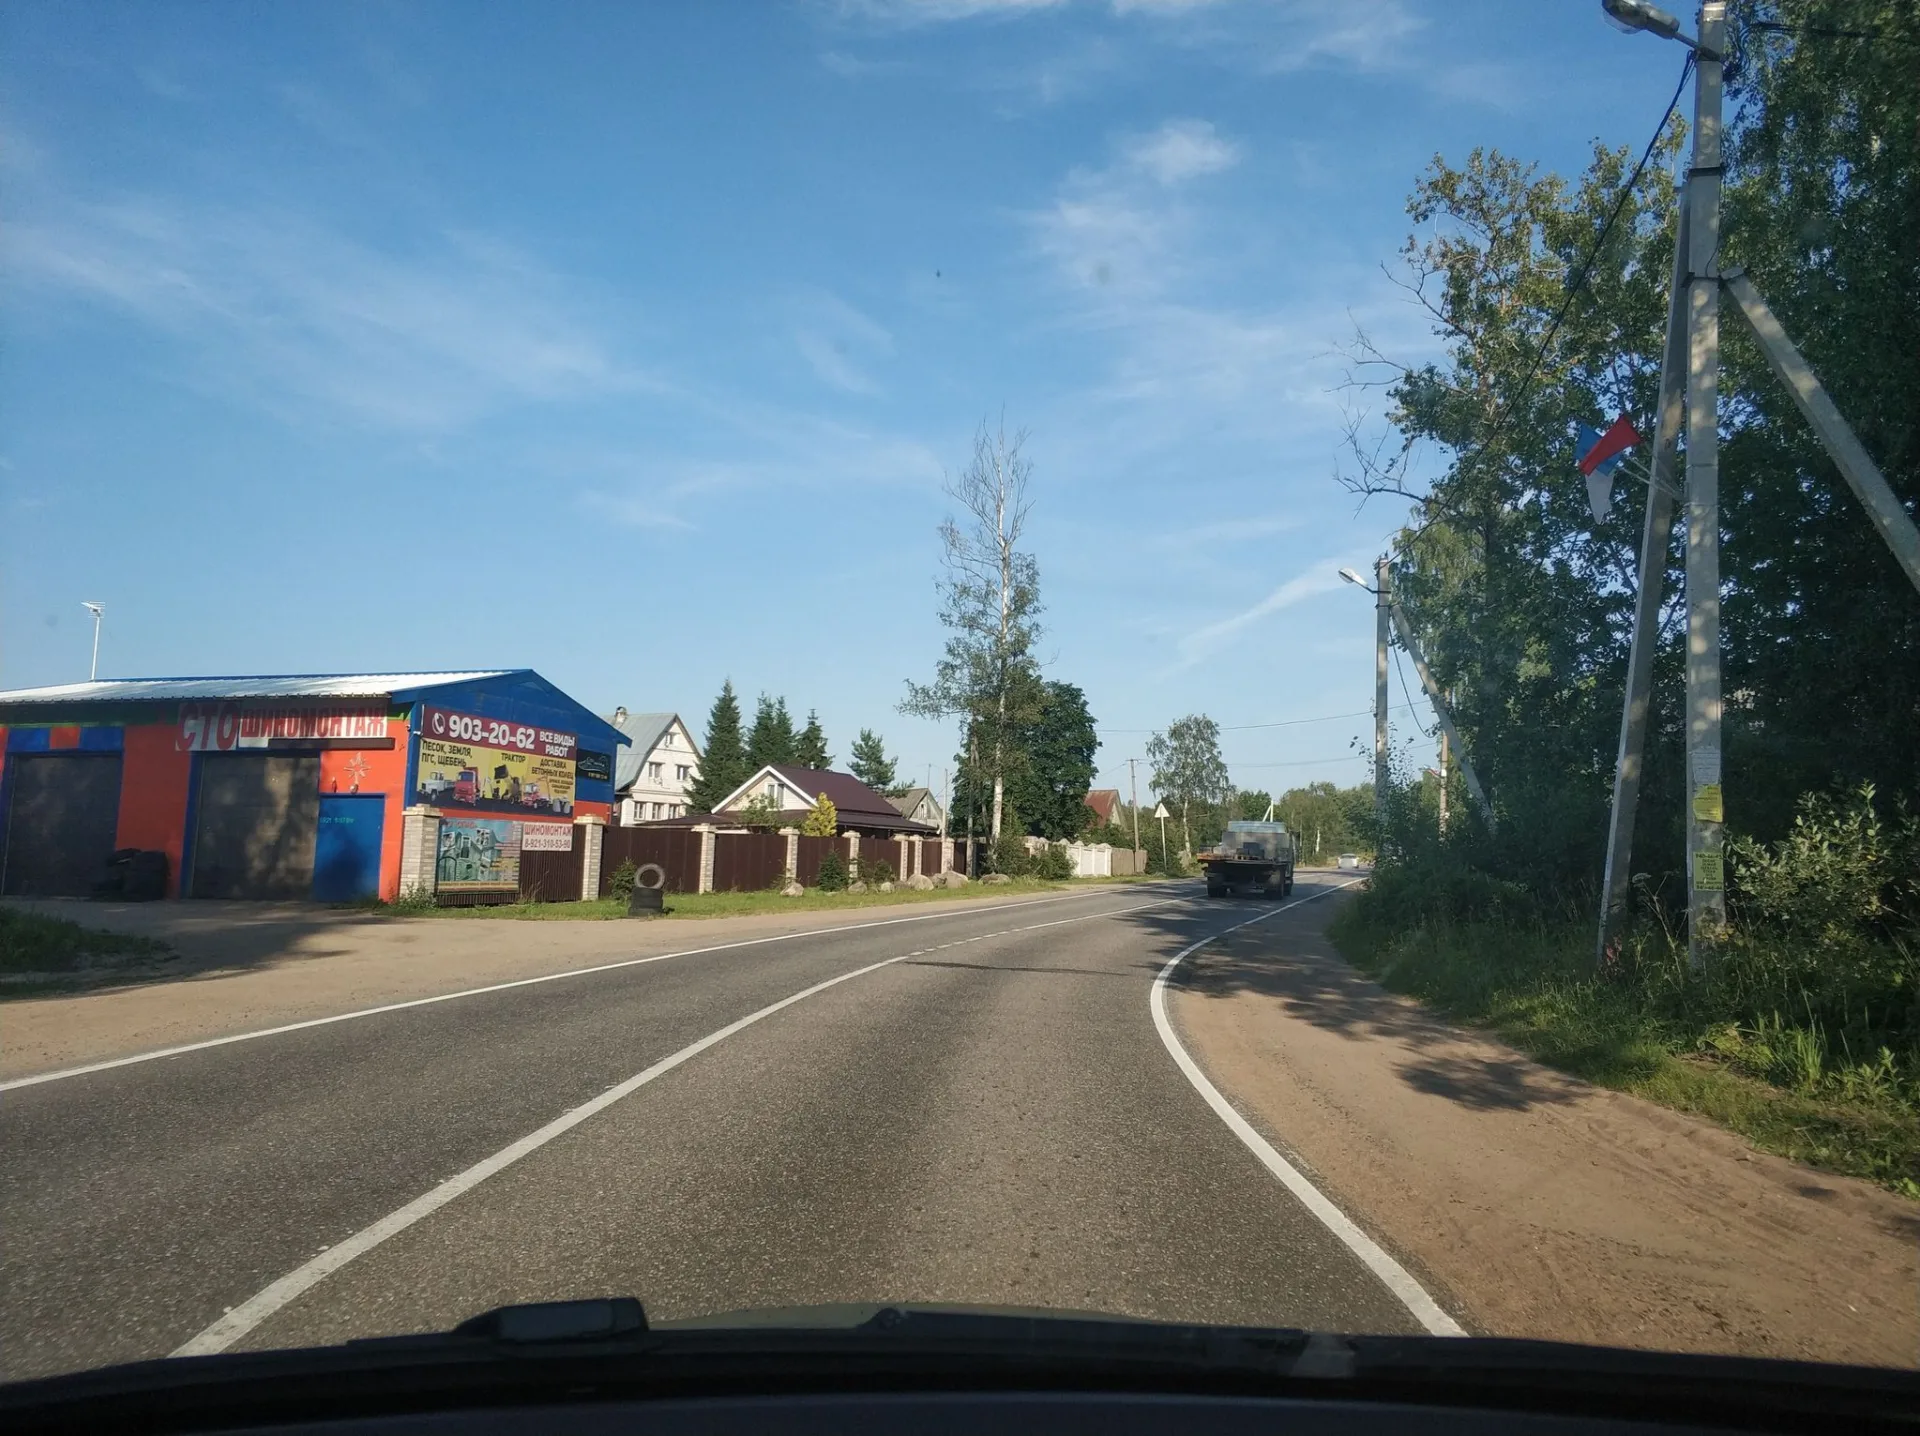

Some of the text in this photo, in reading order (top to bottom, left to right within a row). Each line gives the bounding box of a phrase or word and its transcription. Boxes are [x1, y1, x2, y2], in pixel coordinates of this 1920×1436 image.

[176, 701, 239, 750] СТО
[241, 707, 387, 738] ШИНОМОНТАЖ
[449, 715, 535, 749] 903-20-62
[540, 731, 575, 747] ВСЕ ВИДЫ
[422, 740, 472, 758] ПЕСОК, ЗЕМЛЯ,
[545, 744, 568, 757] РАБОТ
[421, 753, 467, 767] ПГС, ЩЕБЕНЬ
[501, 752, 526, 763] ТРАКТОР
[540, 759, 566, 769] ДОСТАВКА
[525, 824, 572, 836] ШИНОМОНТАЖ
